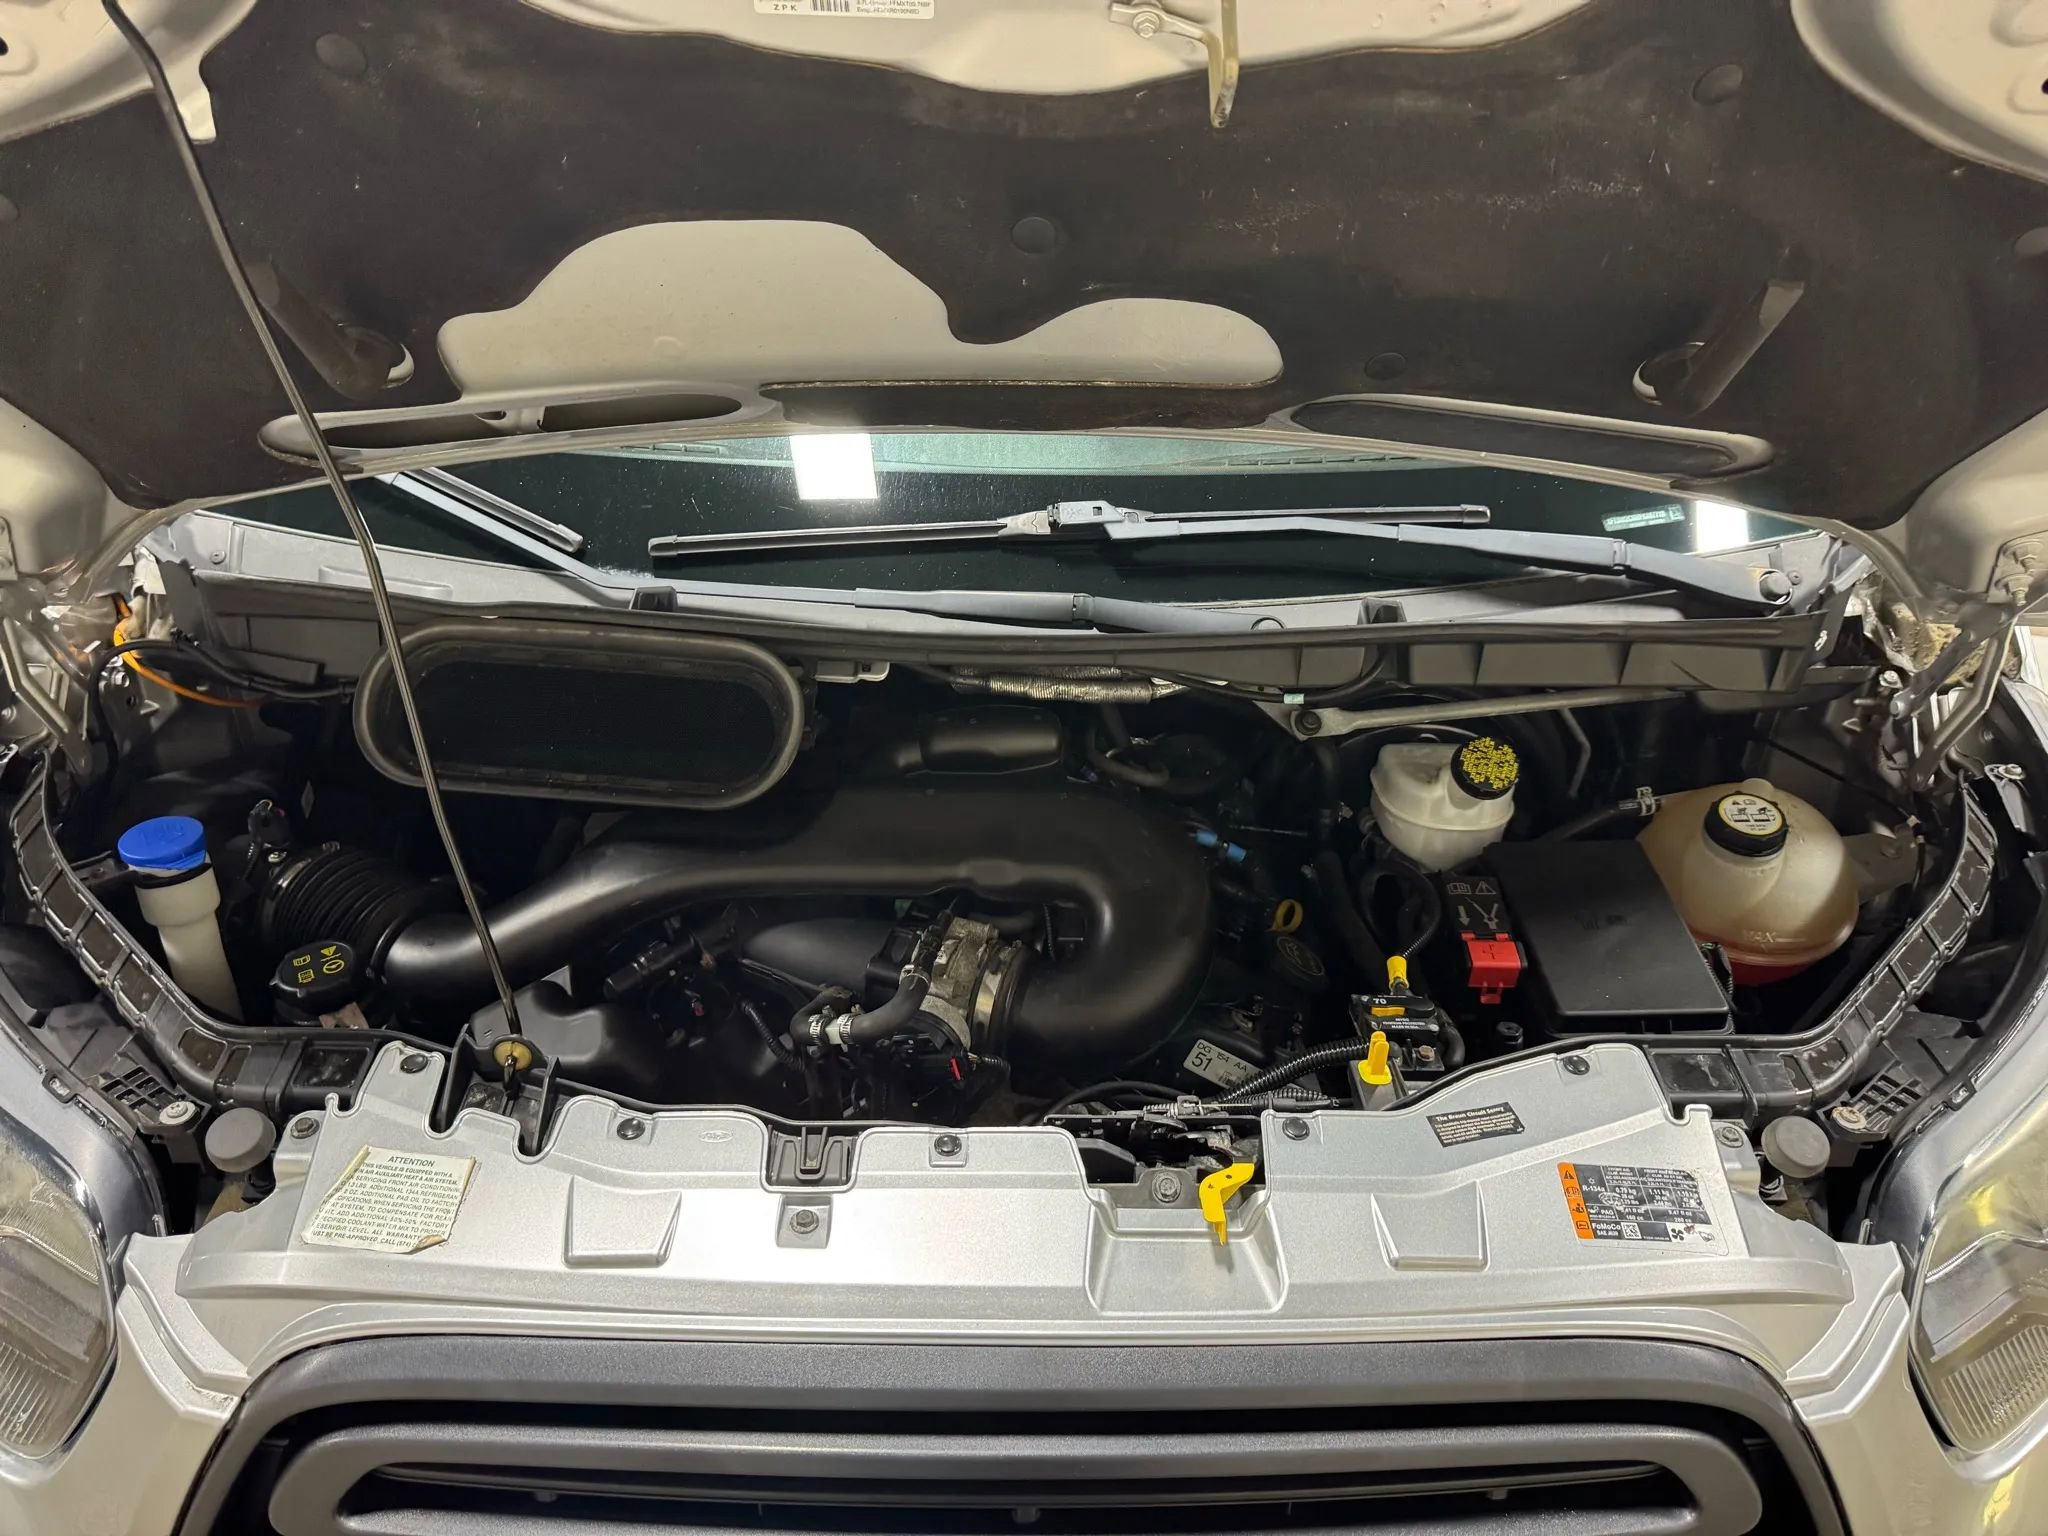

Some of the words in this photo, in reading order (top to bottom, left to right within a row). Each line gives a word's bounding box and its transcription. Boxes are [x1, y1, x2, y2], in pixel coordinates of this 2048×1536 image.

[1197, 1042, 1212, 1053] DG
[1191, 1052, 1213, 1072] 51
[387, 1156, 436, 1168] ATTENTION
[374, 1170, 403, 1178] AUXILIARY
[405, 1167, 433, 1176] EQUIPPED
[356, 1175, 388, 1184] SERVICING
[387, 1179, 409, 1187] FRONT
[370, 1184, 404, 1194] ADDITIONAL
[360, 1190, 395, 1200] ADDITIONAL
[391, 1201, 423, 1210] SERVICING
[378, 1207, 419, 1217] COMPENSATE
[347, 1218, 376, 1226] COOLANT
[351, 1212, 388, 1221] ADDITIONAL
[420, 1220, 449, 1229] FACTORY
[1592, 1222, 1621, 1230] FoMoCo
